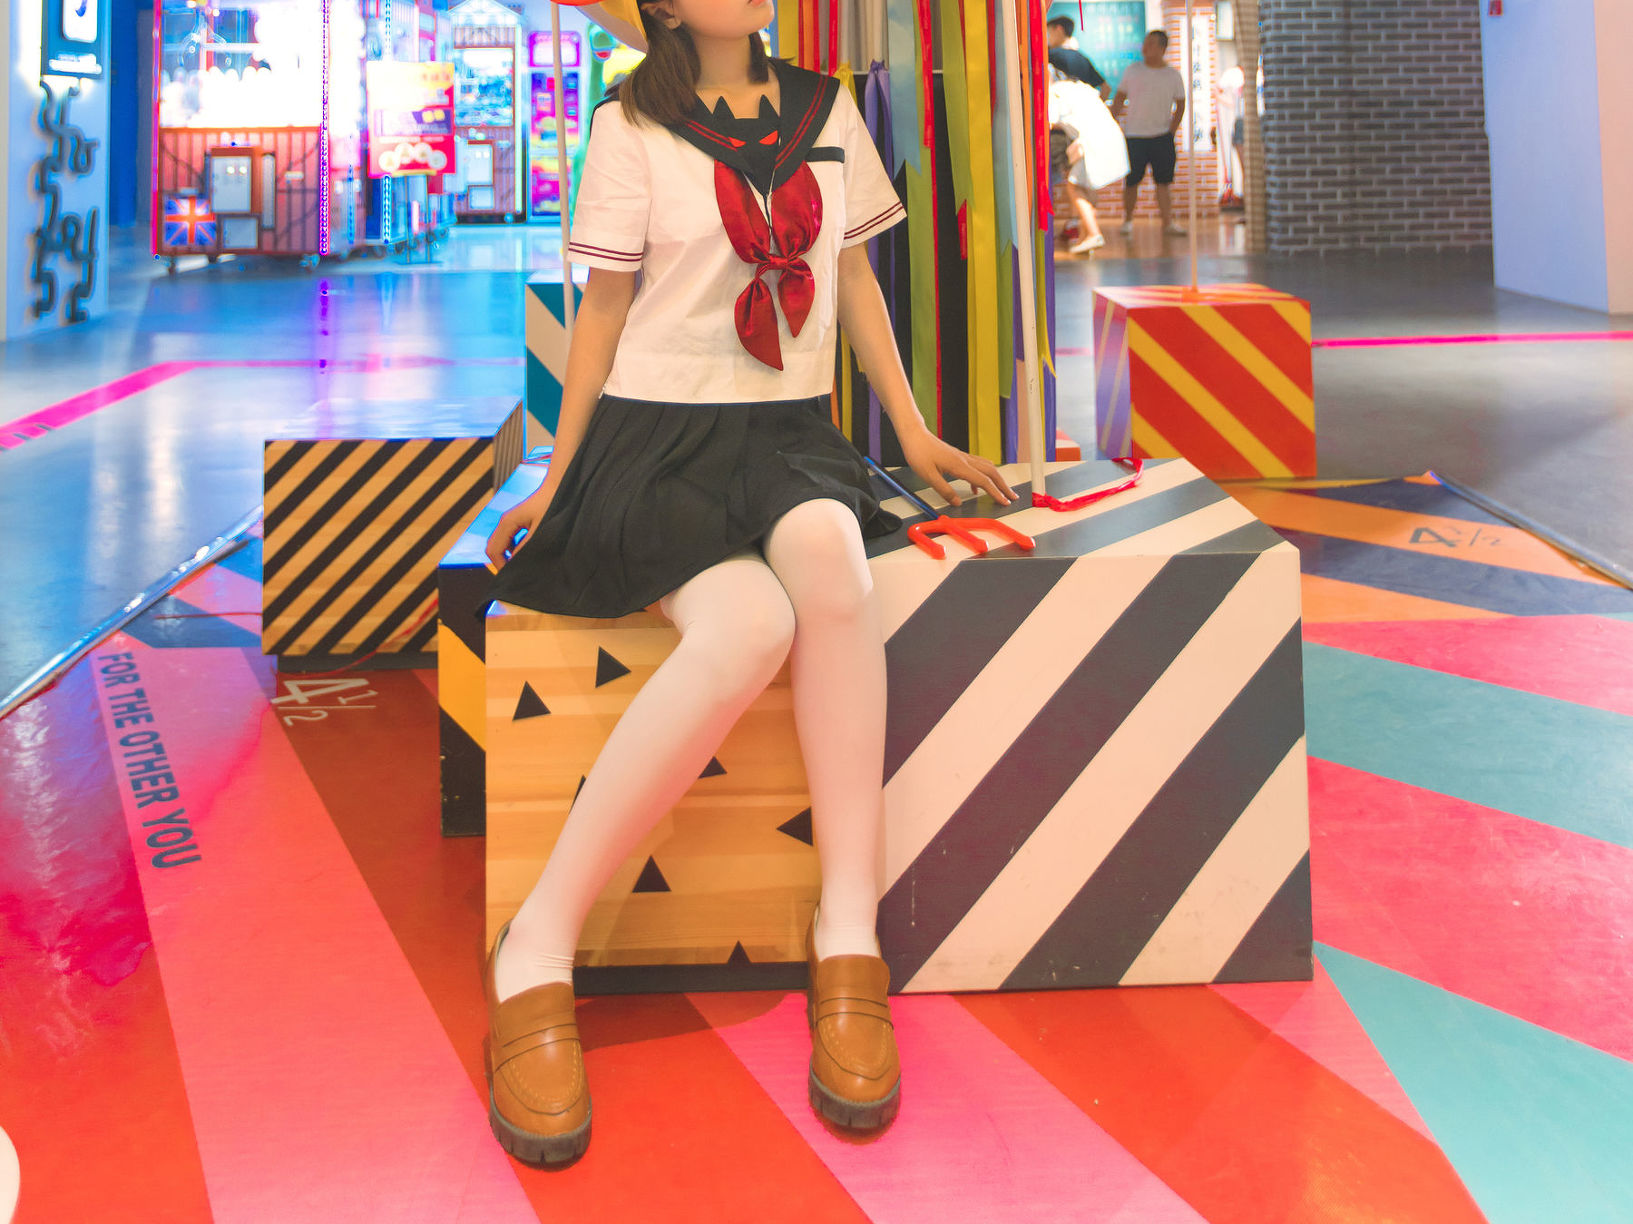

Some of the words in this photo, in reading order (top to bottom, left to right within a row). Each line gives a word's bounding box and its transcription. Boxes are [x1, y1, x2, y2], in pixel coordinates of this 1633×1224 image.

[98, 652, 140, 689] FOR
[108, 687, 155, 729] THE
[119, 730, 180, 809] OTHER
[142, 807, 202, 869] YOU
